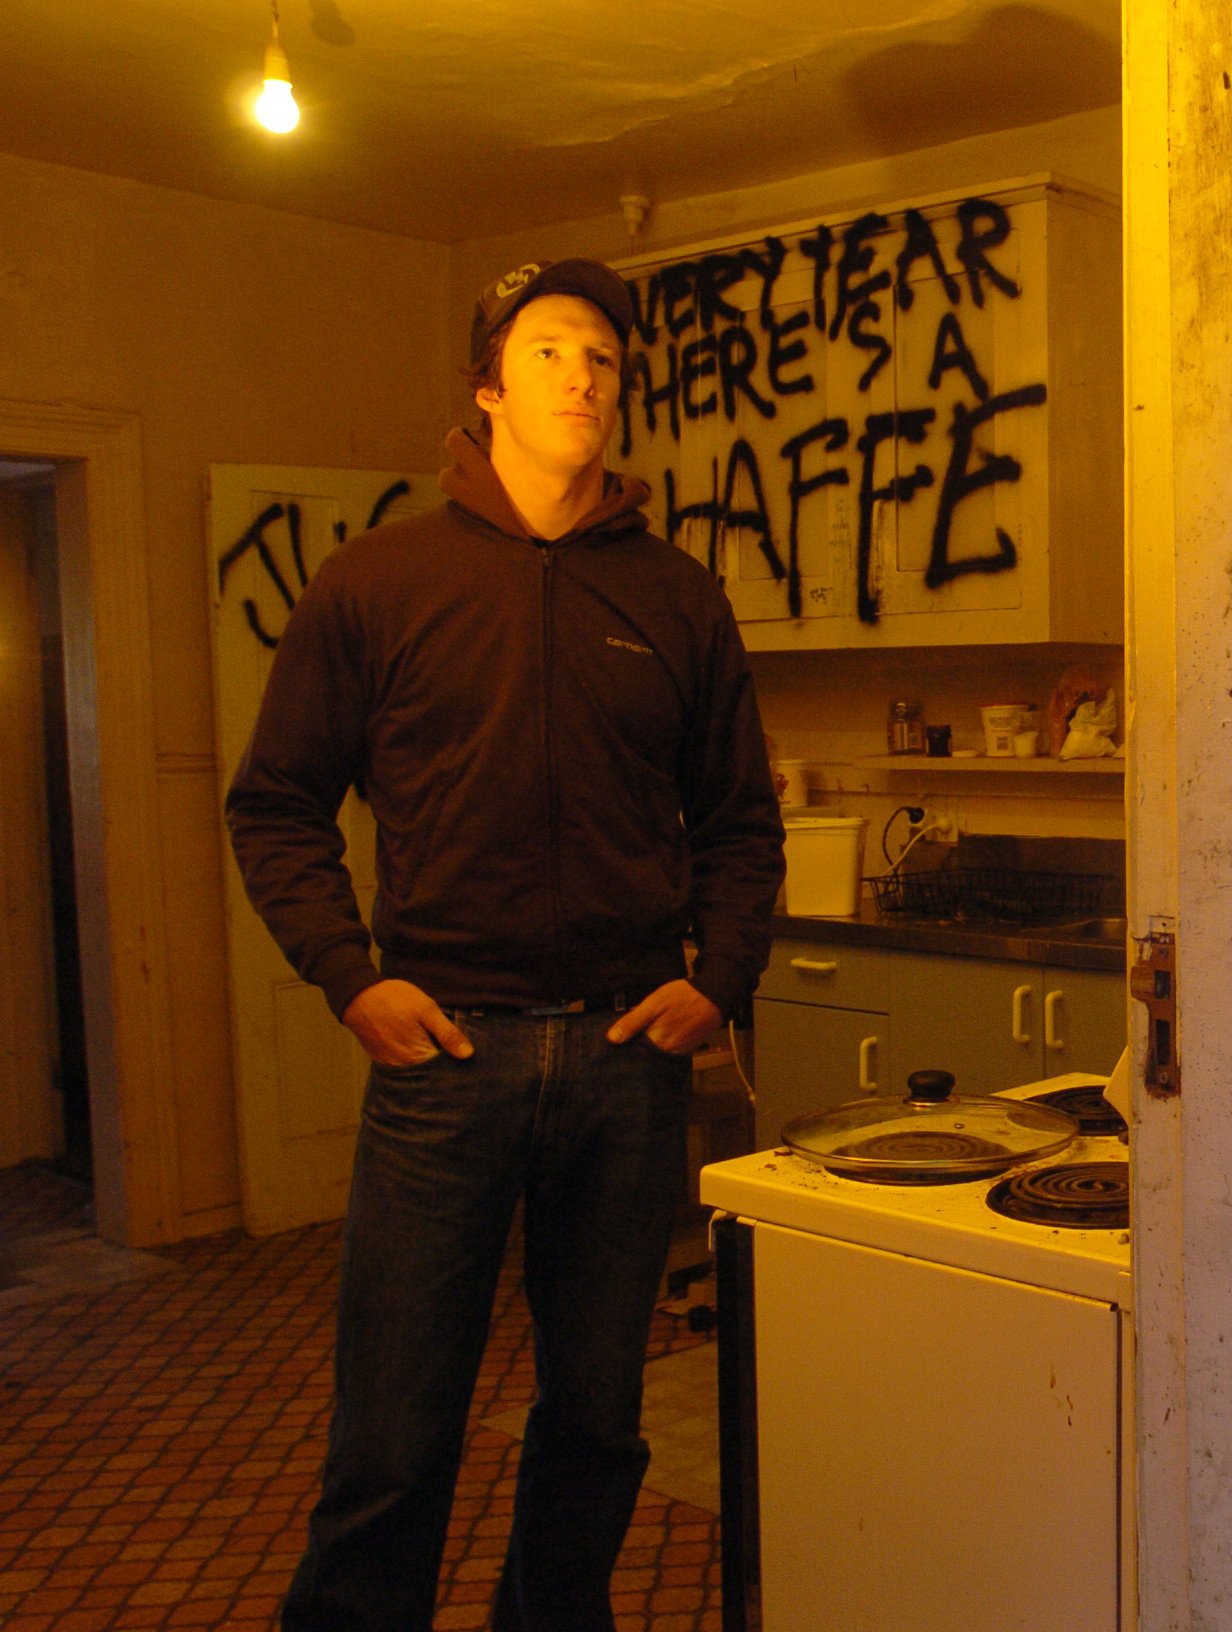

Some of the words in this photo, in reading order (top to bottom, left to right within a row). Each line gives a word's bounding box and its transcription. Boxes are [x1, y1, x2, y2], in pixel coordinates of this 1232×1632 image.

[628, 236, 788, 344] VERY
[799, 198, 1021, 334] YEAR
[928, 312, 990, 400] A
